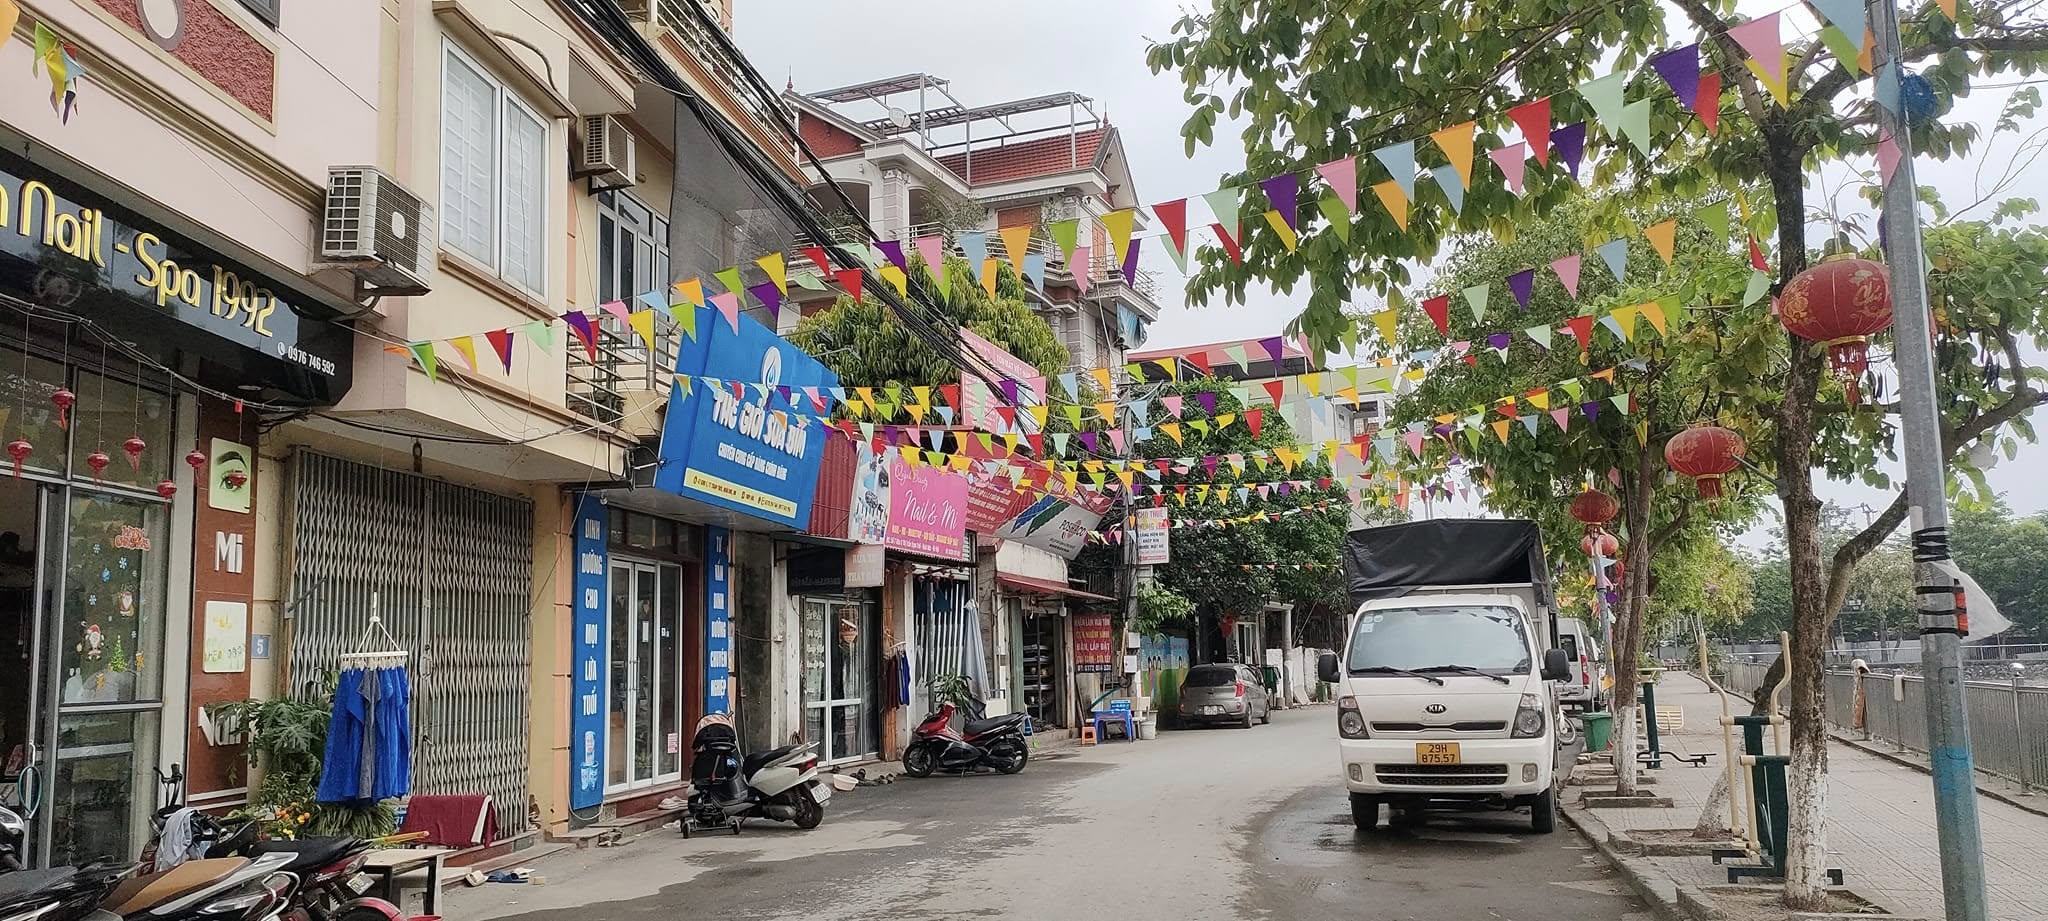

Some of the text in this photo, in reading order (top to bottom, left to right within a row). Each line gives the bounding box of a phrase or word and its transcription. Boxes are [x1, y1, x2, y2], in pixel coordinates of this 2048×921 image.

[18, 180, 106, 268] Nail
[134, 232, 201, 307] Spa
[212, 264, 276, 338] 1992
[287, 345, 335, 377] 0976 746 592
[904, 489, 929, 523] Nail
[940, 499, 959, 530] Mi
[213, 530, 243, 574] Mi
[585, 587, 598, 610] CHO
[254, 638, 265, 656] 5
[1428, 744, 1447, 753] 29H
